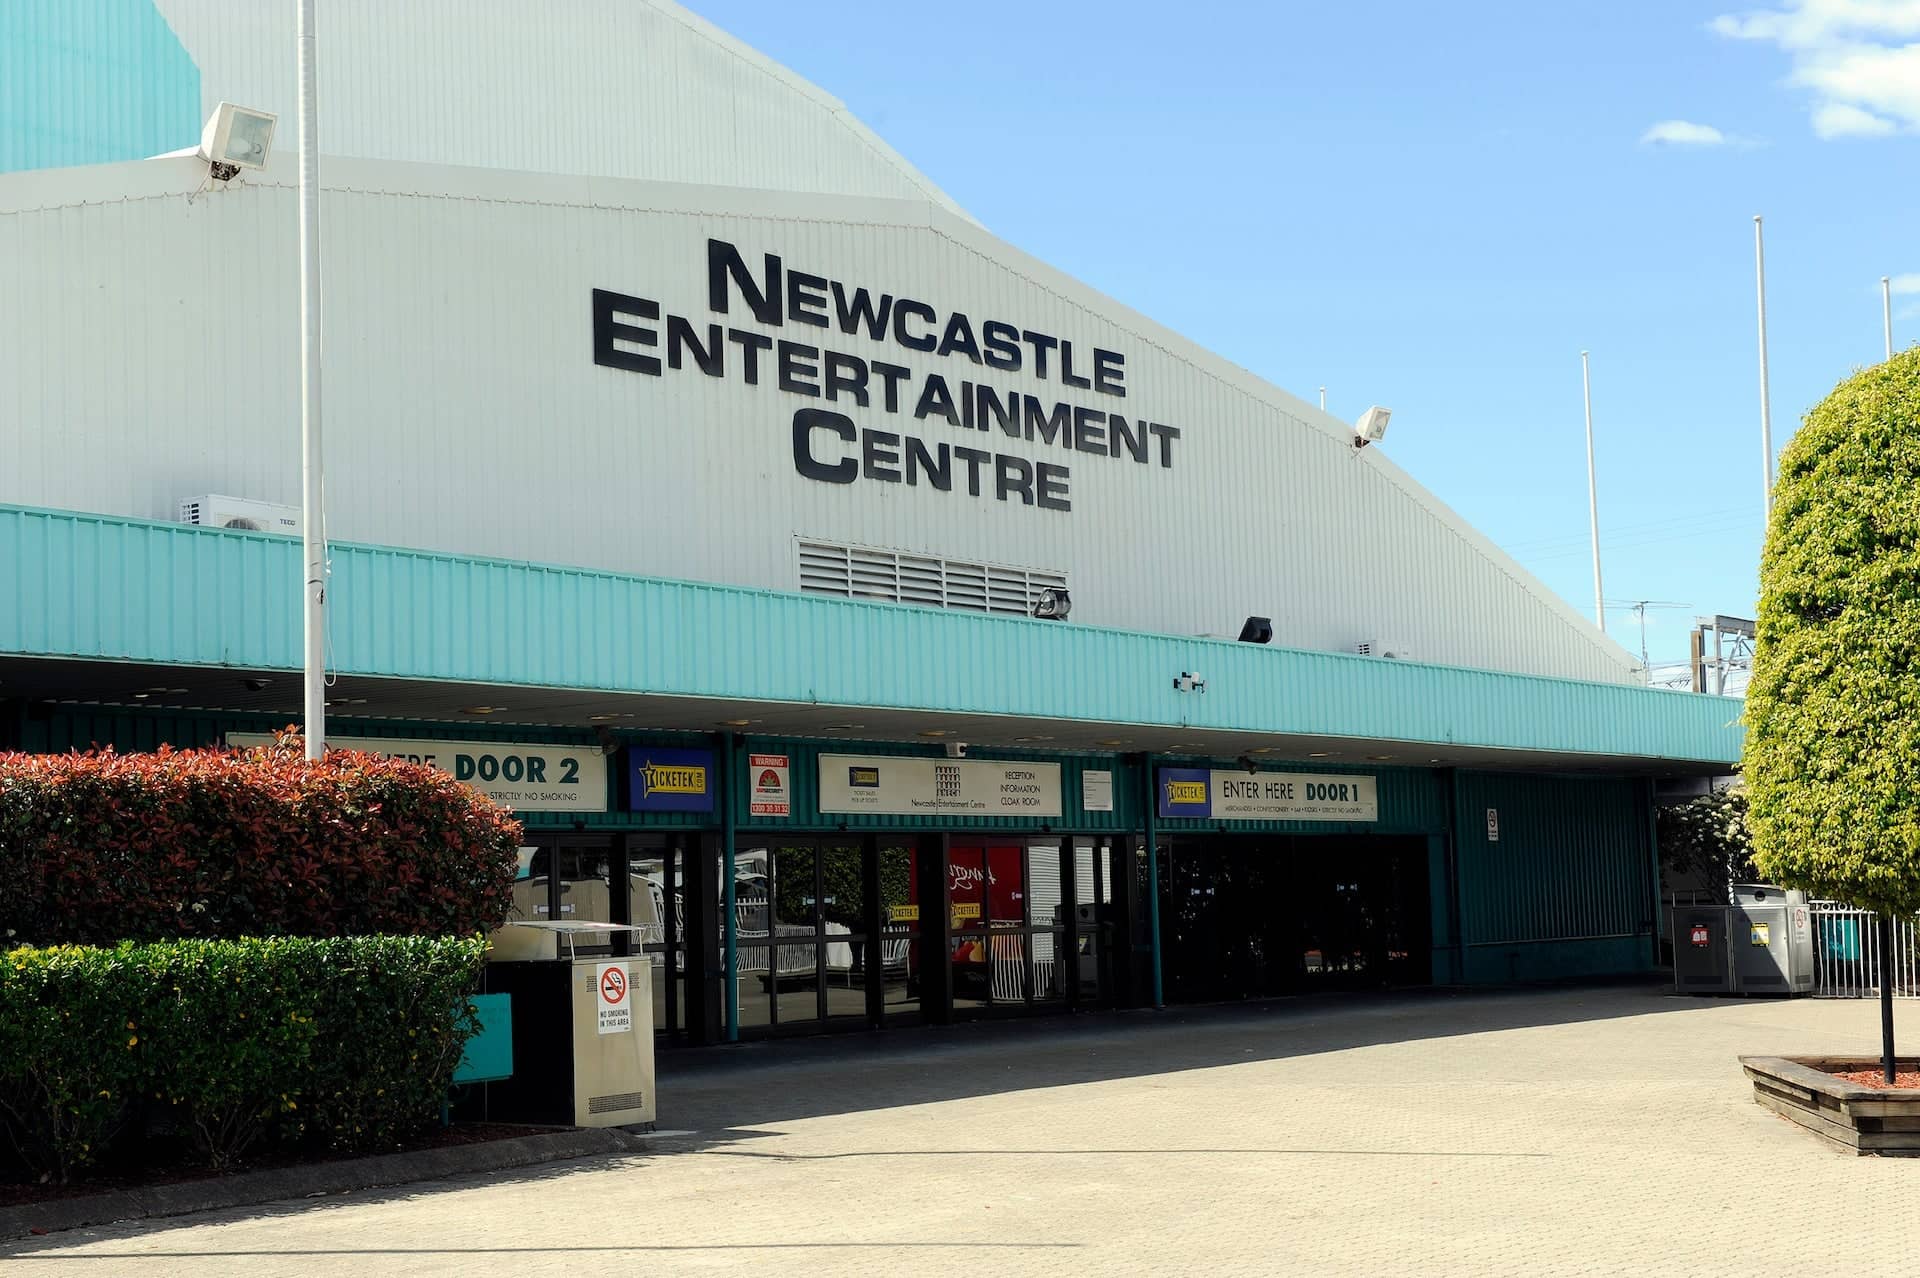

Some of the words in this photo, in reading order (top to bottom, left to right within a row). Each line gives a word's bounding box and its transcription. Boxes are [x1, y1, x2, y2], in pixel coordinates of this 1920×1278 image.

[708, 237, 1127, 397] NEWCASTLE
[592, 287, 1181, 469] ENTERTAINMENT
[792, 407, 1071, 512] CENTRE
[755, 757, 784, 766] WARNING
[456, 754, 547, 783] DOOR
[559, 758, 580, 784] 2
[1005, 771, 1035, 780] RECEPTION
[645, 769, 694, 788] TICKETEK
[1001, 784, 1040, 793] INFORMATION
[1223, 781, 1259, 799] ENTER
[1265, 782, 1294, 800] HERE
[1306, 783, 1349, 802] DOOR
[1351, 784, 1358, 802] 1
[490, 791, 521, 800] STRICTLY
[525, 792, 538, 800] NO
[540, 792, 577, 801] SMOKING
[1001, 797, 1020, 806] CLOAK
[1022, 797, 1040, 806] ROOM
[608, 1009, 628, 1017] SMOKING
